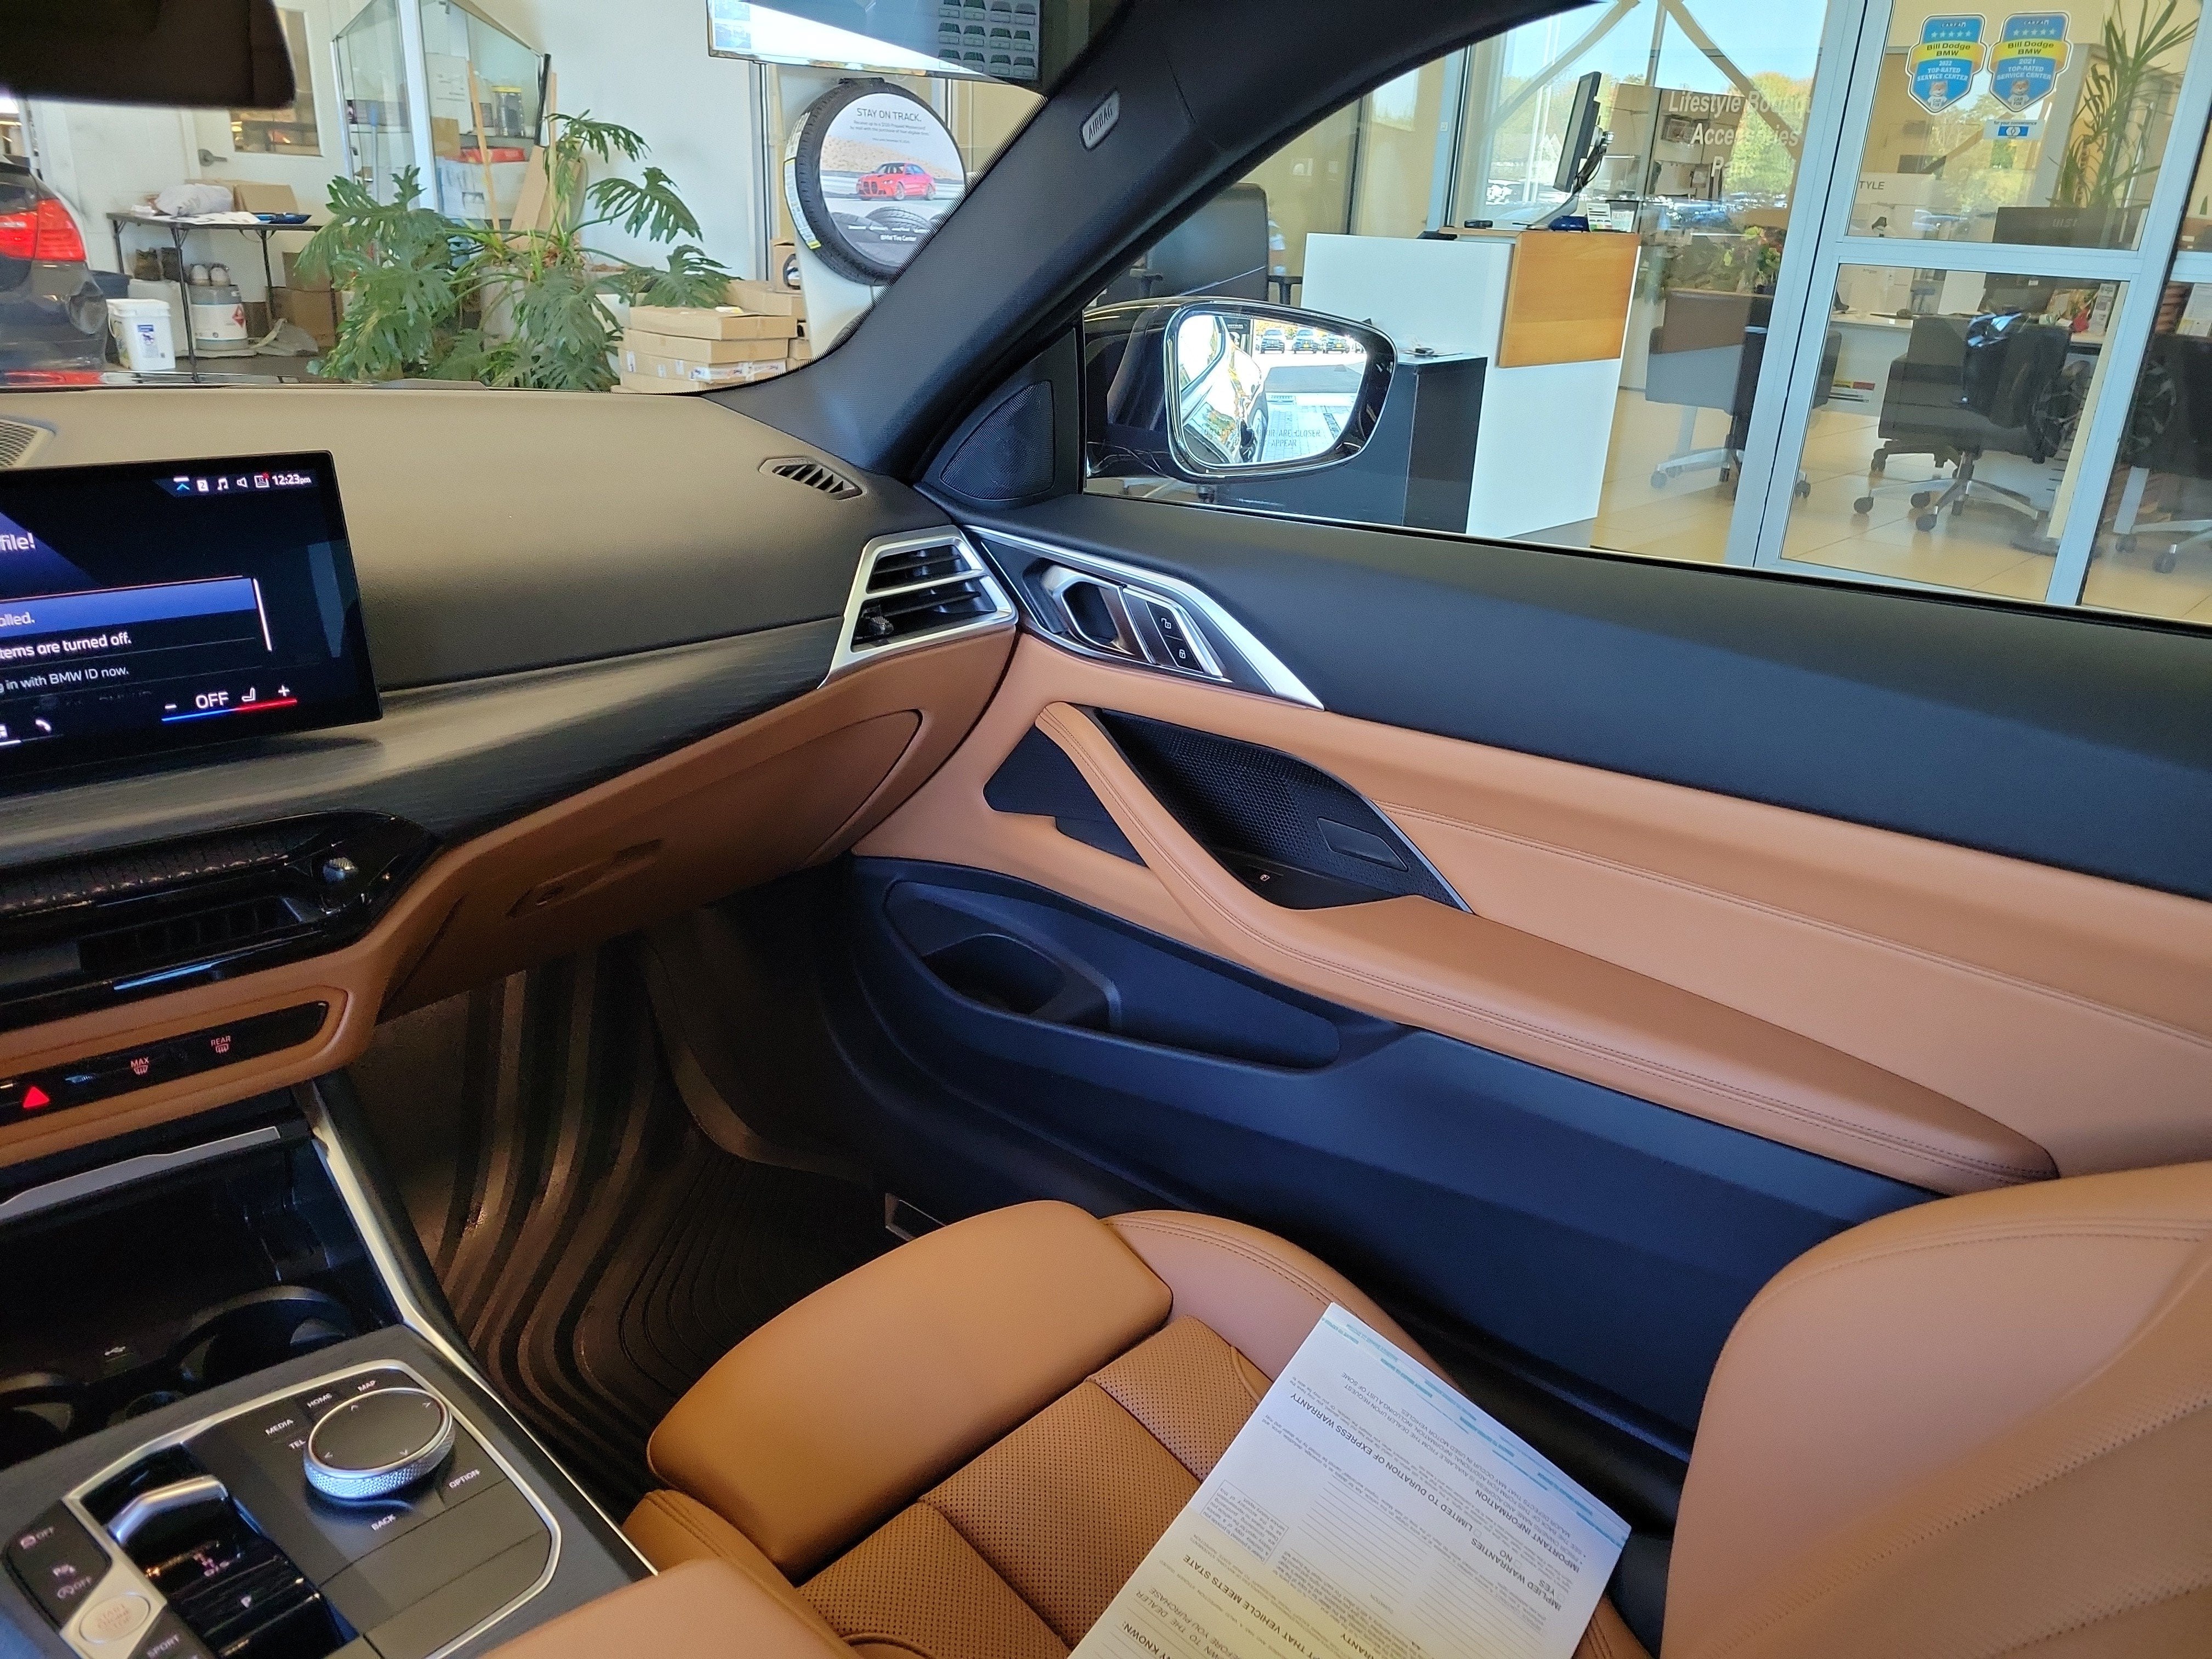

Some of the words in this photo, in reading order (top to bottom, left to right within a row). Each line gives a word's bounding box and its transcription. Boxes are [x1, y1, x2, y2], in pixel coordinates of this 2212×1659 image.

[1668, 91, 1742, 118] Lifestyle
[857, 108, 877, 117] STAY
[879, 110, 891, 119] ON
[892, 111, 922, 122] TRACK.
[1279, 429, 1291, 437] ARE
[272, 474, 312, 486] 12:23pm
[37, 642, 60, 654] are
[63, 634, 108, 652] turned
[110, 631, 132, 646] off.
[6, 679, 19, 690] in
[20, 675, 47, 689] with
[49, 670, 82, 685] BMW
[84, 668, 98, 680] ID
[101, 666, 129, 678] now.
[196, 692, 229, 709] OFF
[211, 1035, 231, 1047] REAR
[131, 1057, 150, 1068] MAX
[357, 1380, 377, 1392] MAP
[1340, 1370, 1359, 1387] SOME
[1357, 1383, 1367, 1393] OF
[1365, 1389, 1379, 1402] LIST
[307, 1392, 333, 1408] HOME
[1289, 1390, 1336, 1430] WARRANTY
[1369, 1402, 1387, 1418] UPON
[1382, 1402, 1414, 1429] INCLUDING
[265, 1419, 294, 1435] MEDIA
[1386, 1414, 1410, 1435] DEALER
[1398, 1406, 1429, 1432] VEHICLES.
[289, 1439, 307, 1450] TEL
[1334, 1423, 1374, 1457] EXPRESS
[1409, 1431, 1422, 1443] THE
[1412, 1424, 1454, 1458] INFORMATION,
[1427, 1428, 1450, 1447] MOTOR
[1420, 1440, 1440, 1456] FROM
[1448, 1444, 1466, 1459] USED
[1372, 1451, 1386, 1465] OF
[1437, 1452, 1469, 1479] AVAILABLE
[1452, 1453, 1487, 1482] ADDITIONAL
[1472, 1460, 1495, 1480] OCCUR
[448, 1469, 481, 1489] OPTION
[1384, 1460, 1428, 1497] DURATION
[1486, 1479, 1500, 1492] FOR
[1493, 1477, 1508, 1490] MAY
[1219, 1487, 1229, 1496] this
[1426, 1492, 1441, 1506] TO
[1474, 1479, 1504, 1504] ADDRESS
[1498, 1488, 1518, 1505] FORM
[1507, 1487, 1522, 1501] THAT
[1209, 1500, 1218, 1509] you
[1237, 1499, 1258, 1517] accuracy
[1473, 1487, 1532, 1536] INFORMATION
[1502, 1500, 1516, 1513] AND
[1516, 1502, 1531, 1515] THIS
[1521, 1498, 1550, 1522] DEFECTS
[371, 1514, 397, 1531] BACK
[1259, 1517, 1267, 1525] the
[1438, 1502, 1474, 1532] LIMITED
[1515, 1510, 1533, 1527] NAME
[1530, 1513, 1541, 1523] OF
[1239, 1516, 1266, 1538] considering
[1539, 1520, 1558, 1536] BACK
[1549, 1519, 1572, 1538] MAJOR
[1556, 1532, 1570, 1545] THE
[1469, 1536, 1527, 1584] WARRANTIES
[1498, 1548, 1514, 1562] NO
[1531, 1532, 1581, 1573] IMPORTANT
[1559, 1544, 1579, 1562] PRIOR
[1181, 1553, 1212, 1579] STATE
[1210, 1575, 1243, 1604] MEETS
[1537, 1578, 1557, 1596] YES
[1133, 1588, 1169, 1619] DEALER
[1147, 1585, 1193, 1624] PURCHASE
[1525, 1580, 1563, 1612] IMPLIED
[1169, 1617, 1187, 1634] THE
[1241, 1600, 1283, 1634] VEHICLE
[1119, 1620, 1160, 1655] KNOWN:
[1190, 1620, 1211, 1639] YOU
[1187, 1632, 1203, 1646] TO
[1281, 1630, 1307, 1654] THAT
